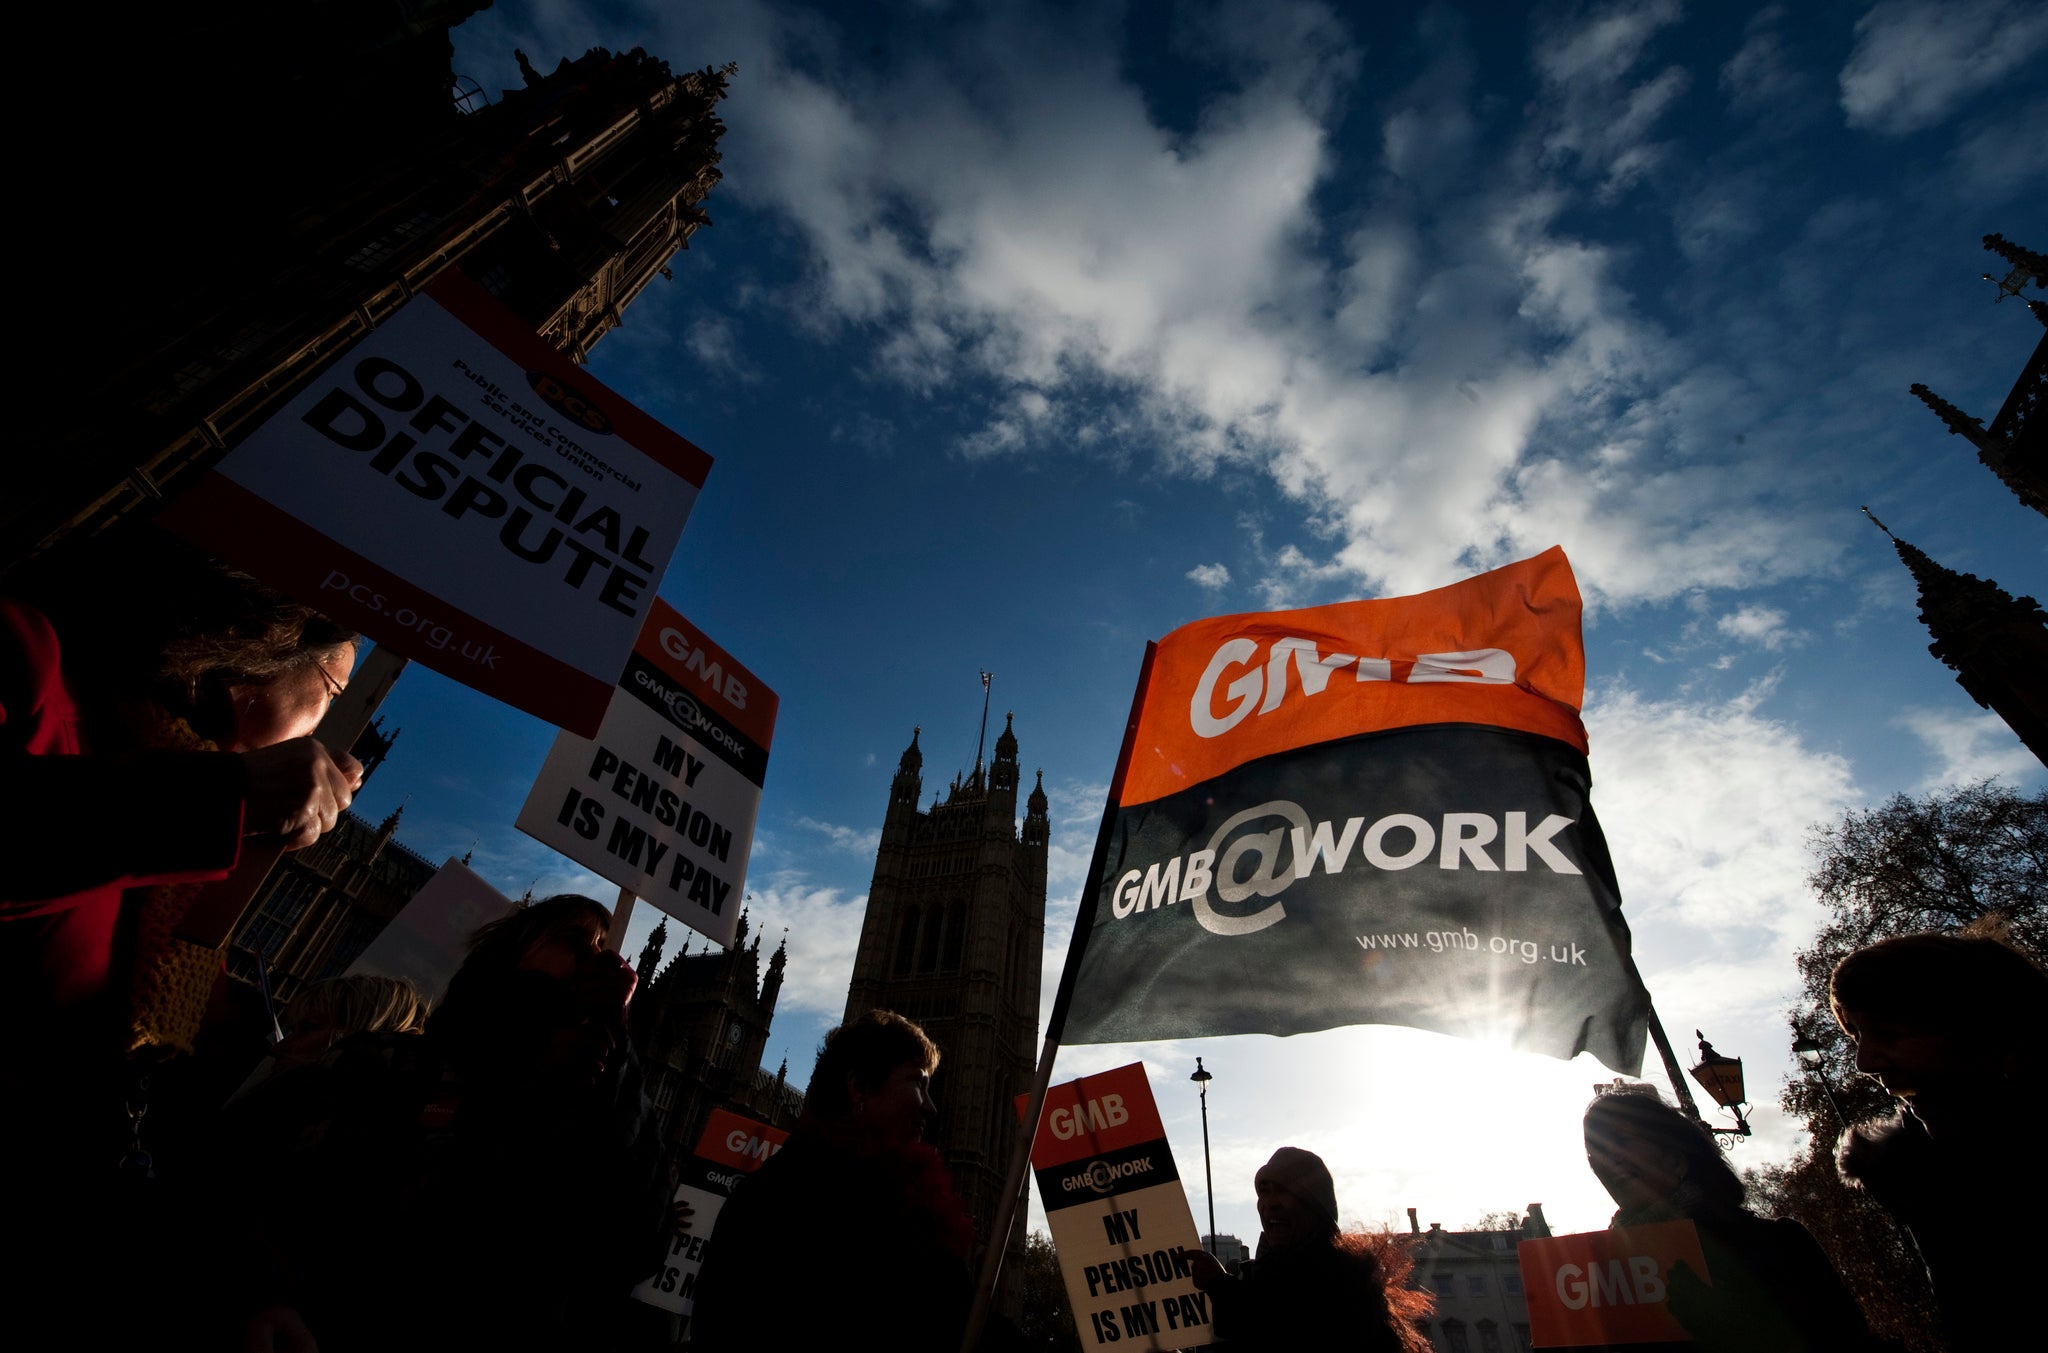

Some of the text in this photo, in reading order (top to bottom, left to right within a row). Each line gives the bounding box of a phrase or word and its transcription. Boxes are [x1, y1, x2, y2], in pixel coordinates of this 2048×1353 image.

[453, 359, 642, 493] Public and Commercial
[480, 394, 604, 482] Services Union
[535, 375, 606, 430] pcs
[301, 386, 647, 618] DISPUTE
[354, 357, 654, 573] OFFICIAL
[319, 569, 503, 671] pcs.org.uk
[659, 627, 748, 710] GMB
[634, 670, 745, 760] GMB@WORK
[653, 735, 702, 787] MY
[589, 746, 732, 863] PENSION
[557, 788, 730, 915] IS MY PAY
[1112, 800, 1583, 937] GMB@WORK
[1356, 926, 1587, 966] www.gmb.org.uk
[1050, 1094, 1129, 1141] GMB
[1061, 1155, 1154, 1194] GMB@WORK
[1102, 1208, 1141, 1246] MY
[1084, 1246, 1191, 1297] PENSION
[1556, 1255, 1667, 1310] GMB
[1091, 1292, 1210, 1344] IS MY PAY
